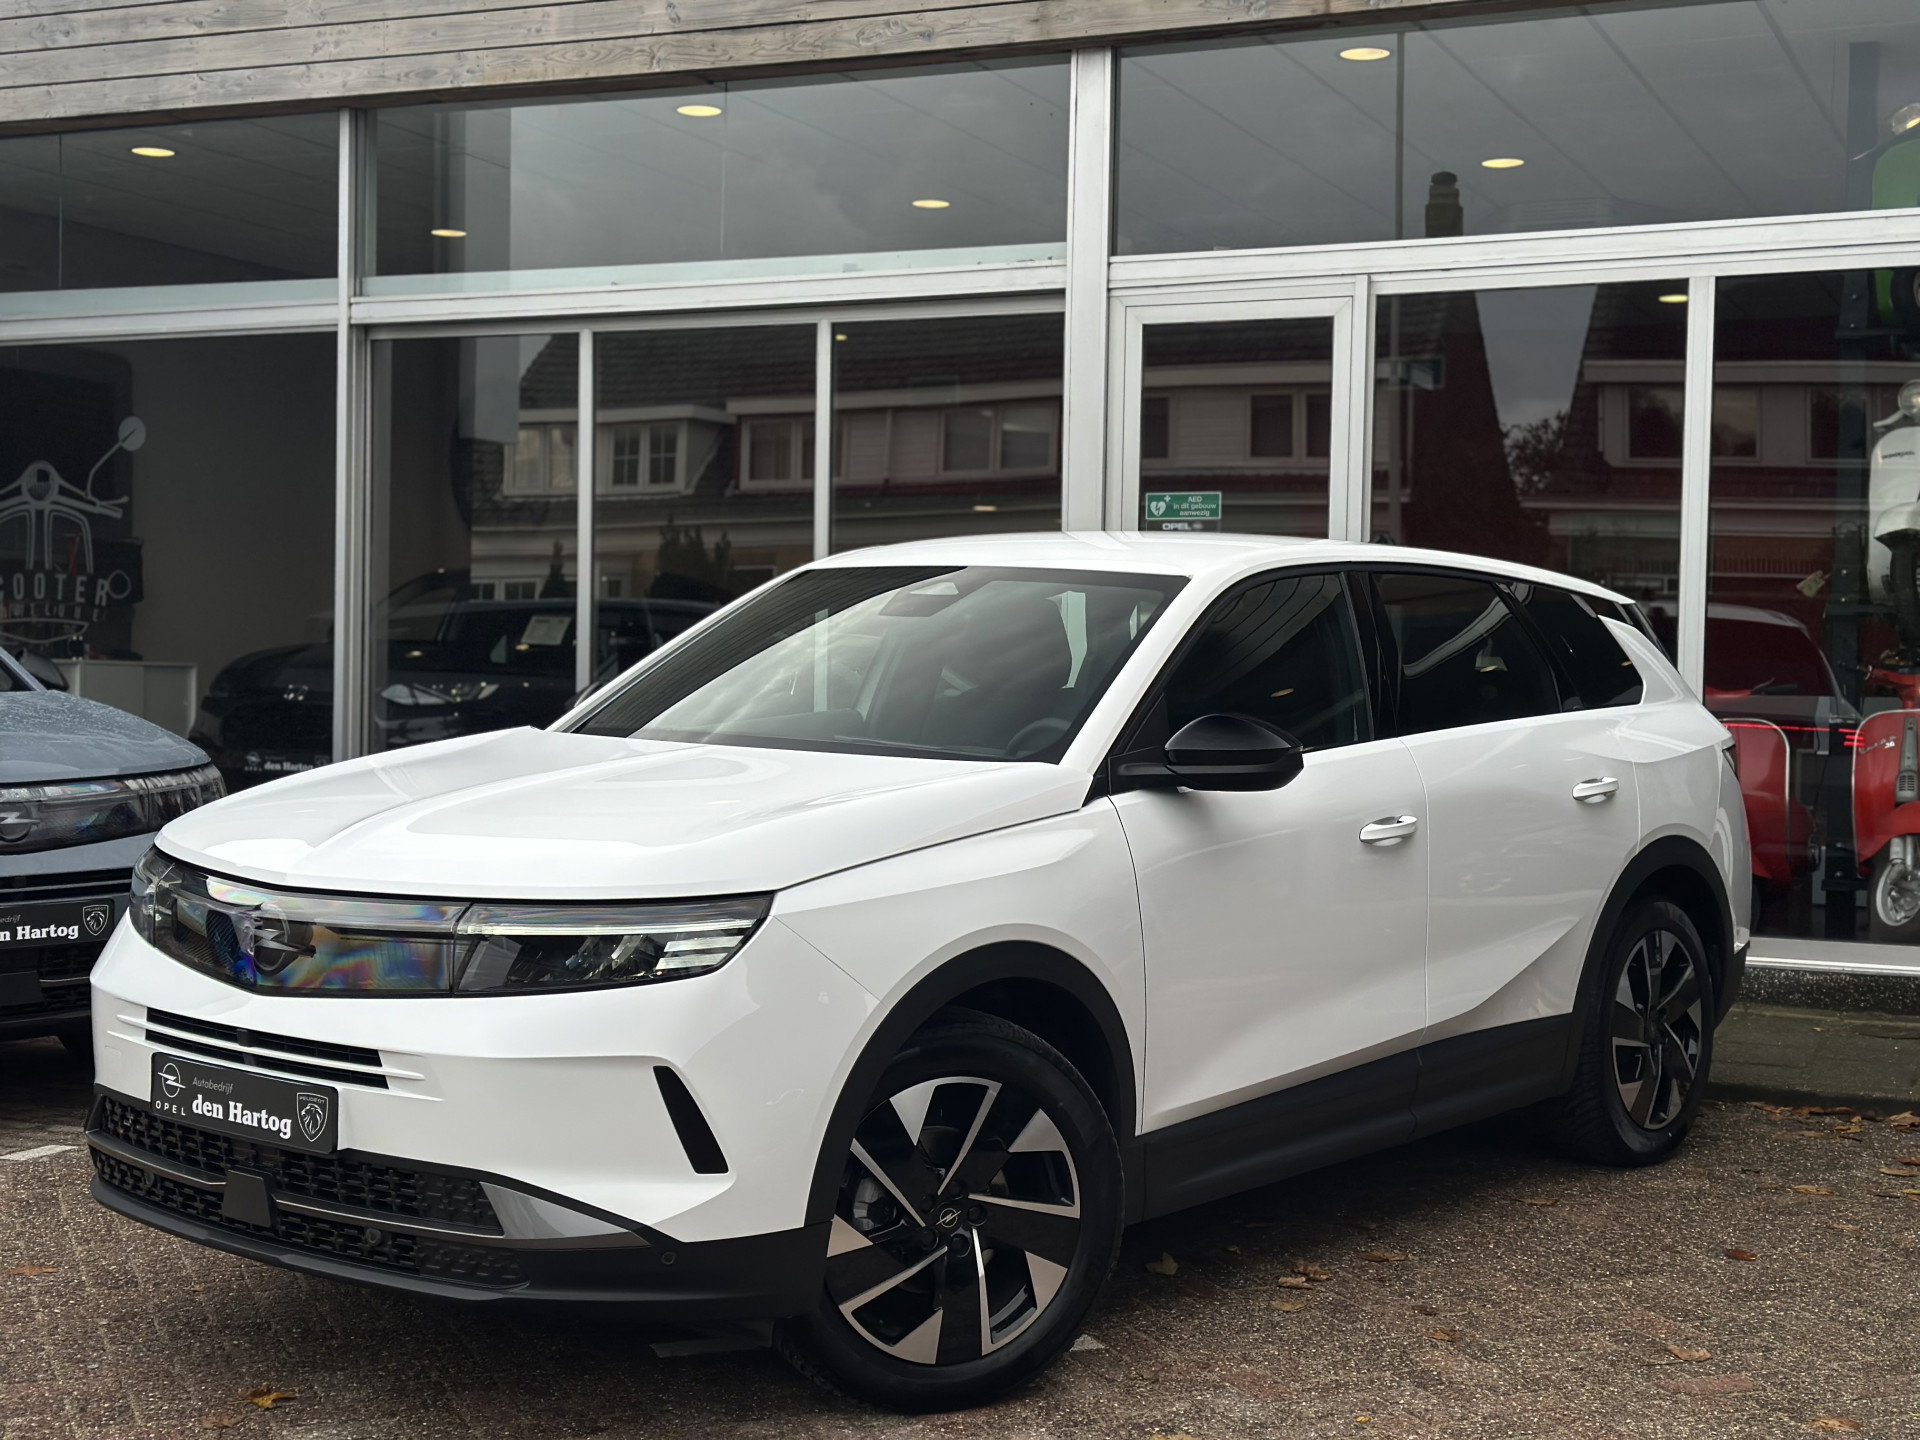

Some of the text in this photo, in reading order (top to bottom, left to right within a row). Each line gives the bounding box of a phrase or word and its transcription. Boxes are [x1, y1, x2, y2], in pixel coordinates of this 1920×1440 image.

[1162, 522, 1191, 531] OPEL
[16, 923, 79, 940] Hartog
[192, 1076, 234, 1095] Autobedrijf
[155, 1100, 187, 1117] OPEL
[191, 1093, 292, 1140] den Hartog
